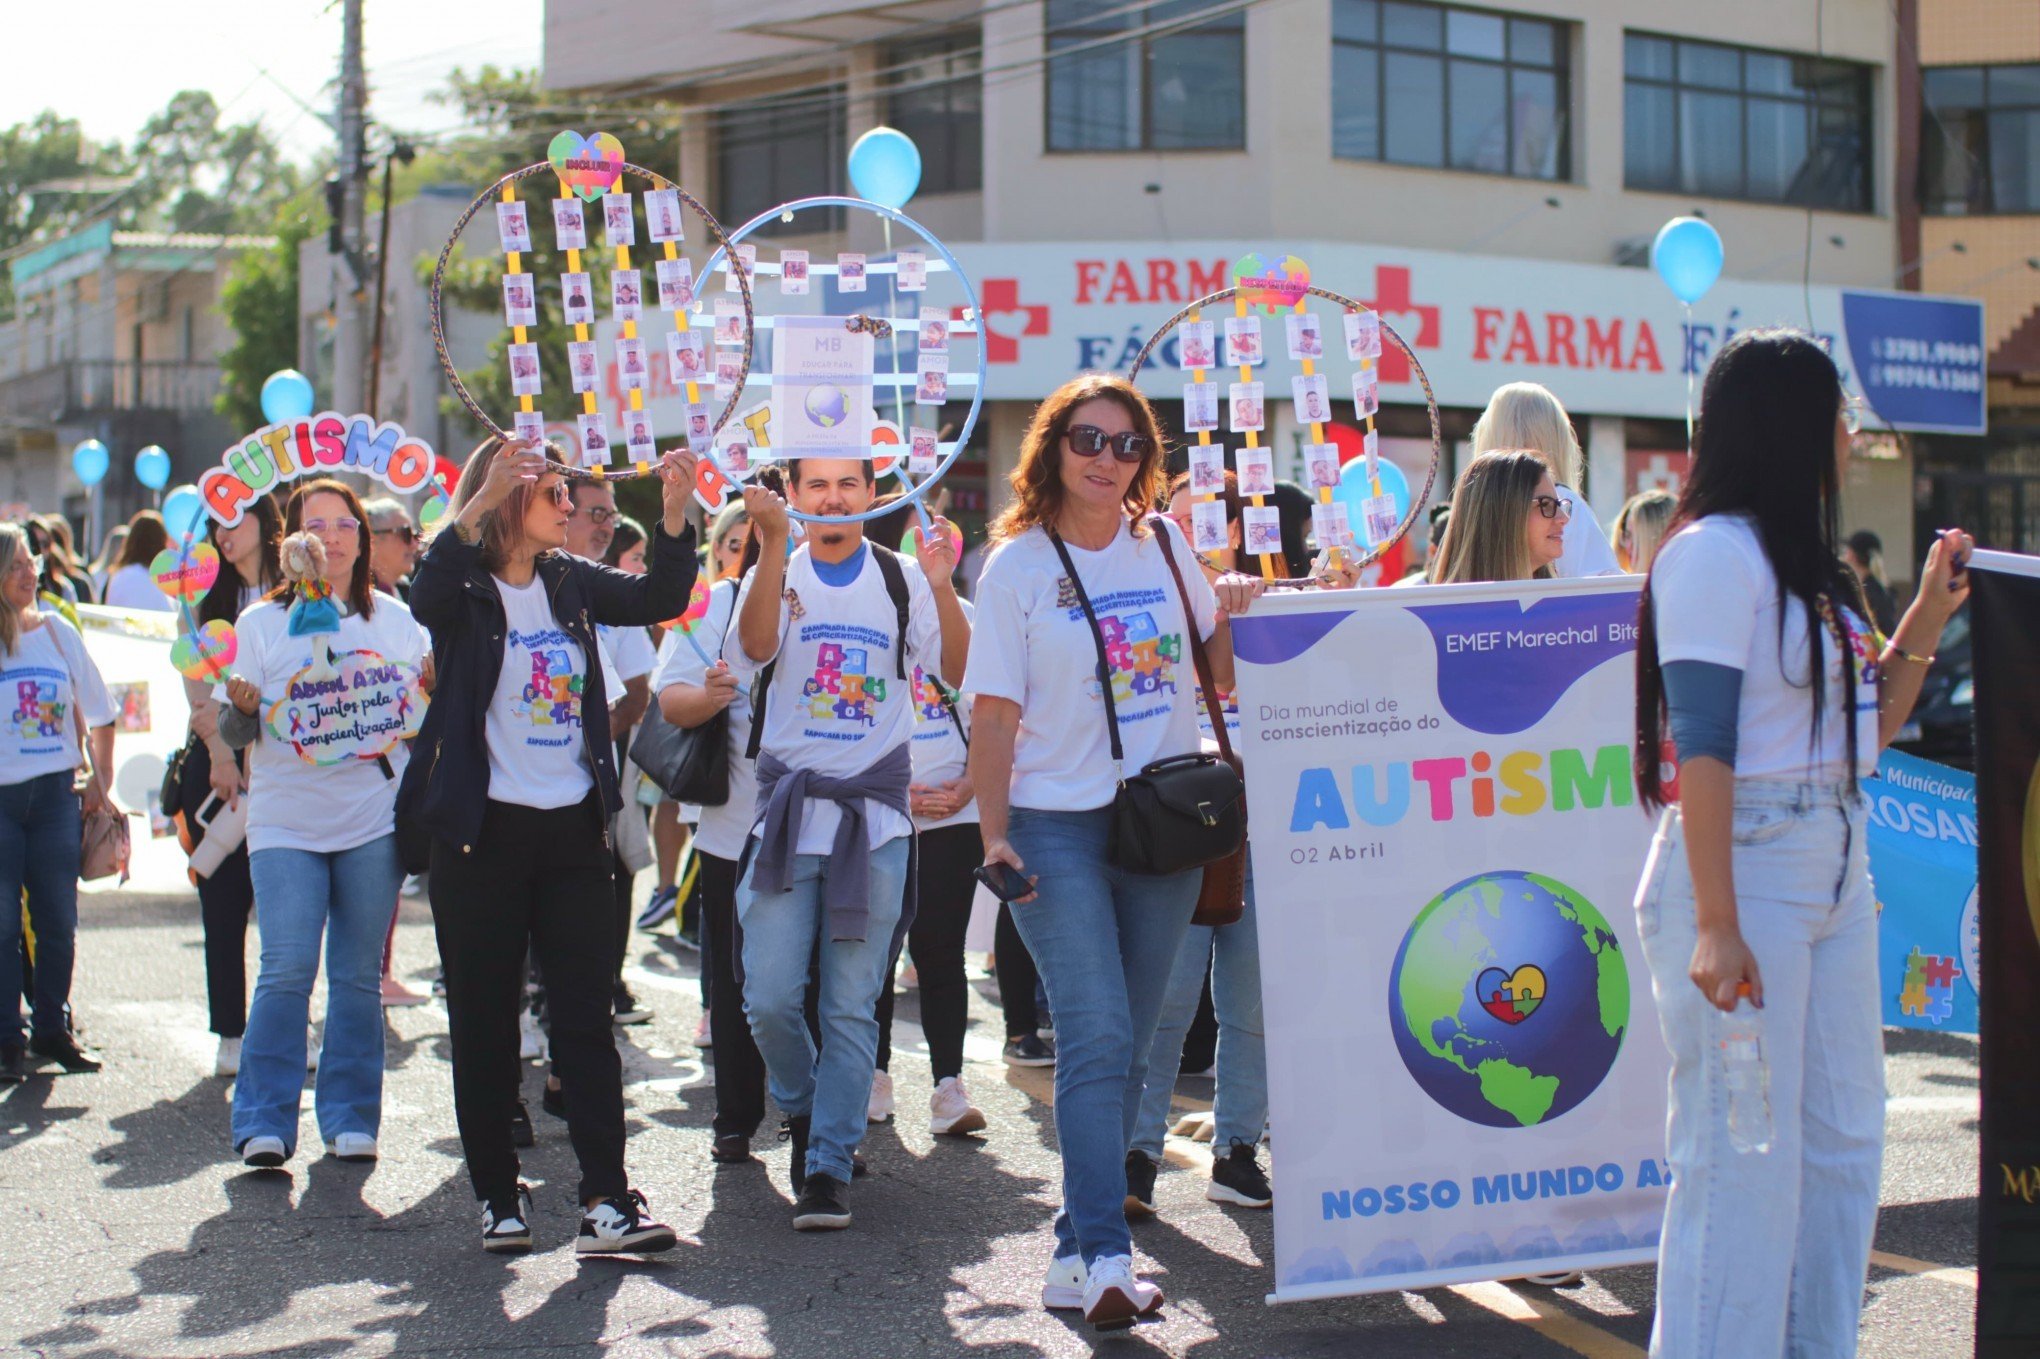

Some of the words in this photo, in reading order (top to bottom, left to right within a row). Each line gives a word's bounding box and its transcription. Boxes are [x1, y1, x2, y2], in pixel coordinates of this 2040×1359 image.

[1074, 258, 1229, 304] FARM
[814, 336, 842, 352] MB
[1471, 307, 1663, 372] FARMA
[204, 418, 429, 521] AUTISMO
[847, 625, 890, 643] MUNICIPAL
[1446, 631, 1501, 653] EMEF
[1506, 625, 1598, 649] Marechal
[353, 663, 403, 690] AZUL
[308, 697, 358, 729] Juntos
[361, 690, 393, 717] pela
[1259, 703, 1291, 722] Dia
[1296, 699, 1370, 719] mundial
[1375, 698, 1399, 714] de
[300, 711, 406, 747] conscientização!
[1260, 715, 1412, 742] conscientização
[1417, 714, 1441, 731] do
[1887, 767, 1972, 802] Municipal
[1328, 843, 1385, 862] Abril
[1322, 1179, 1461, 1221] NOSSO
[1472, 1162, 1624, 1206] MUNDO
